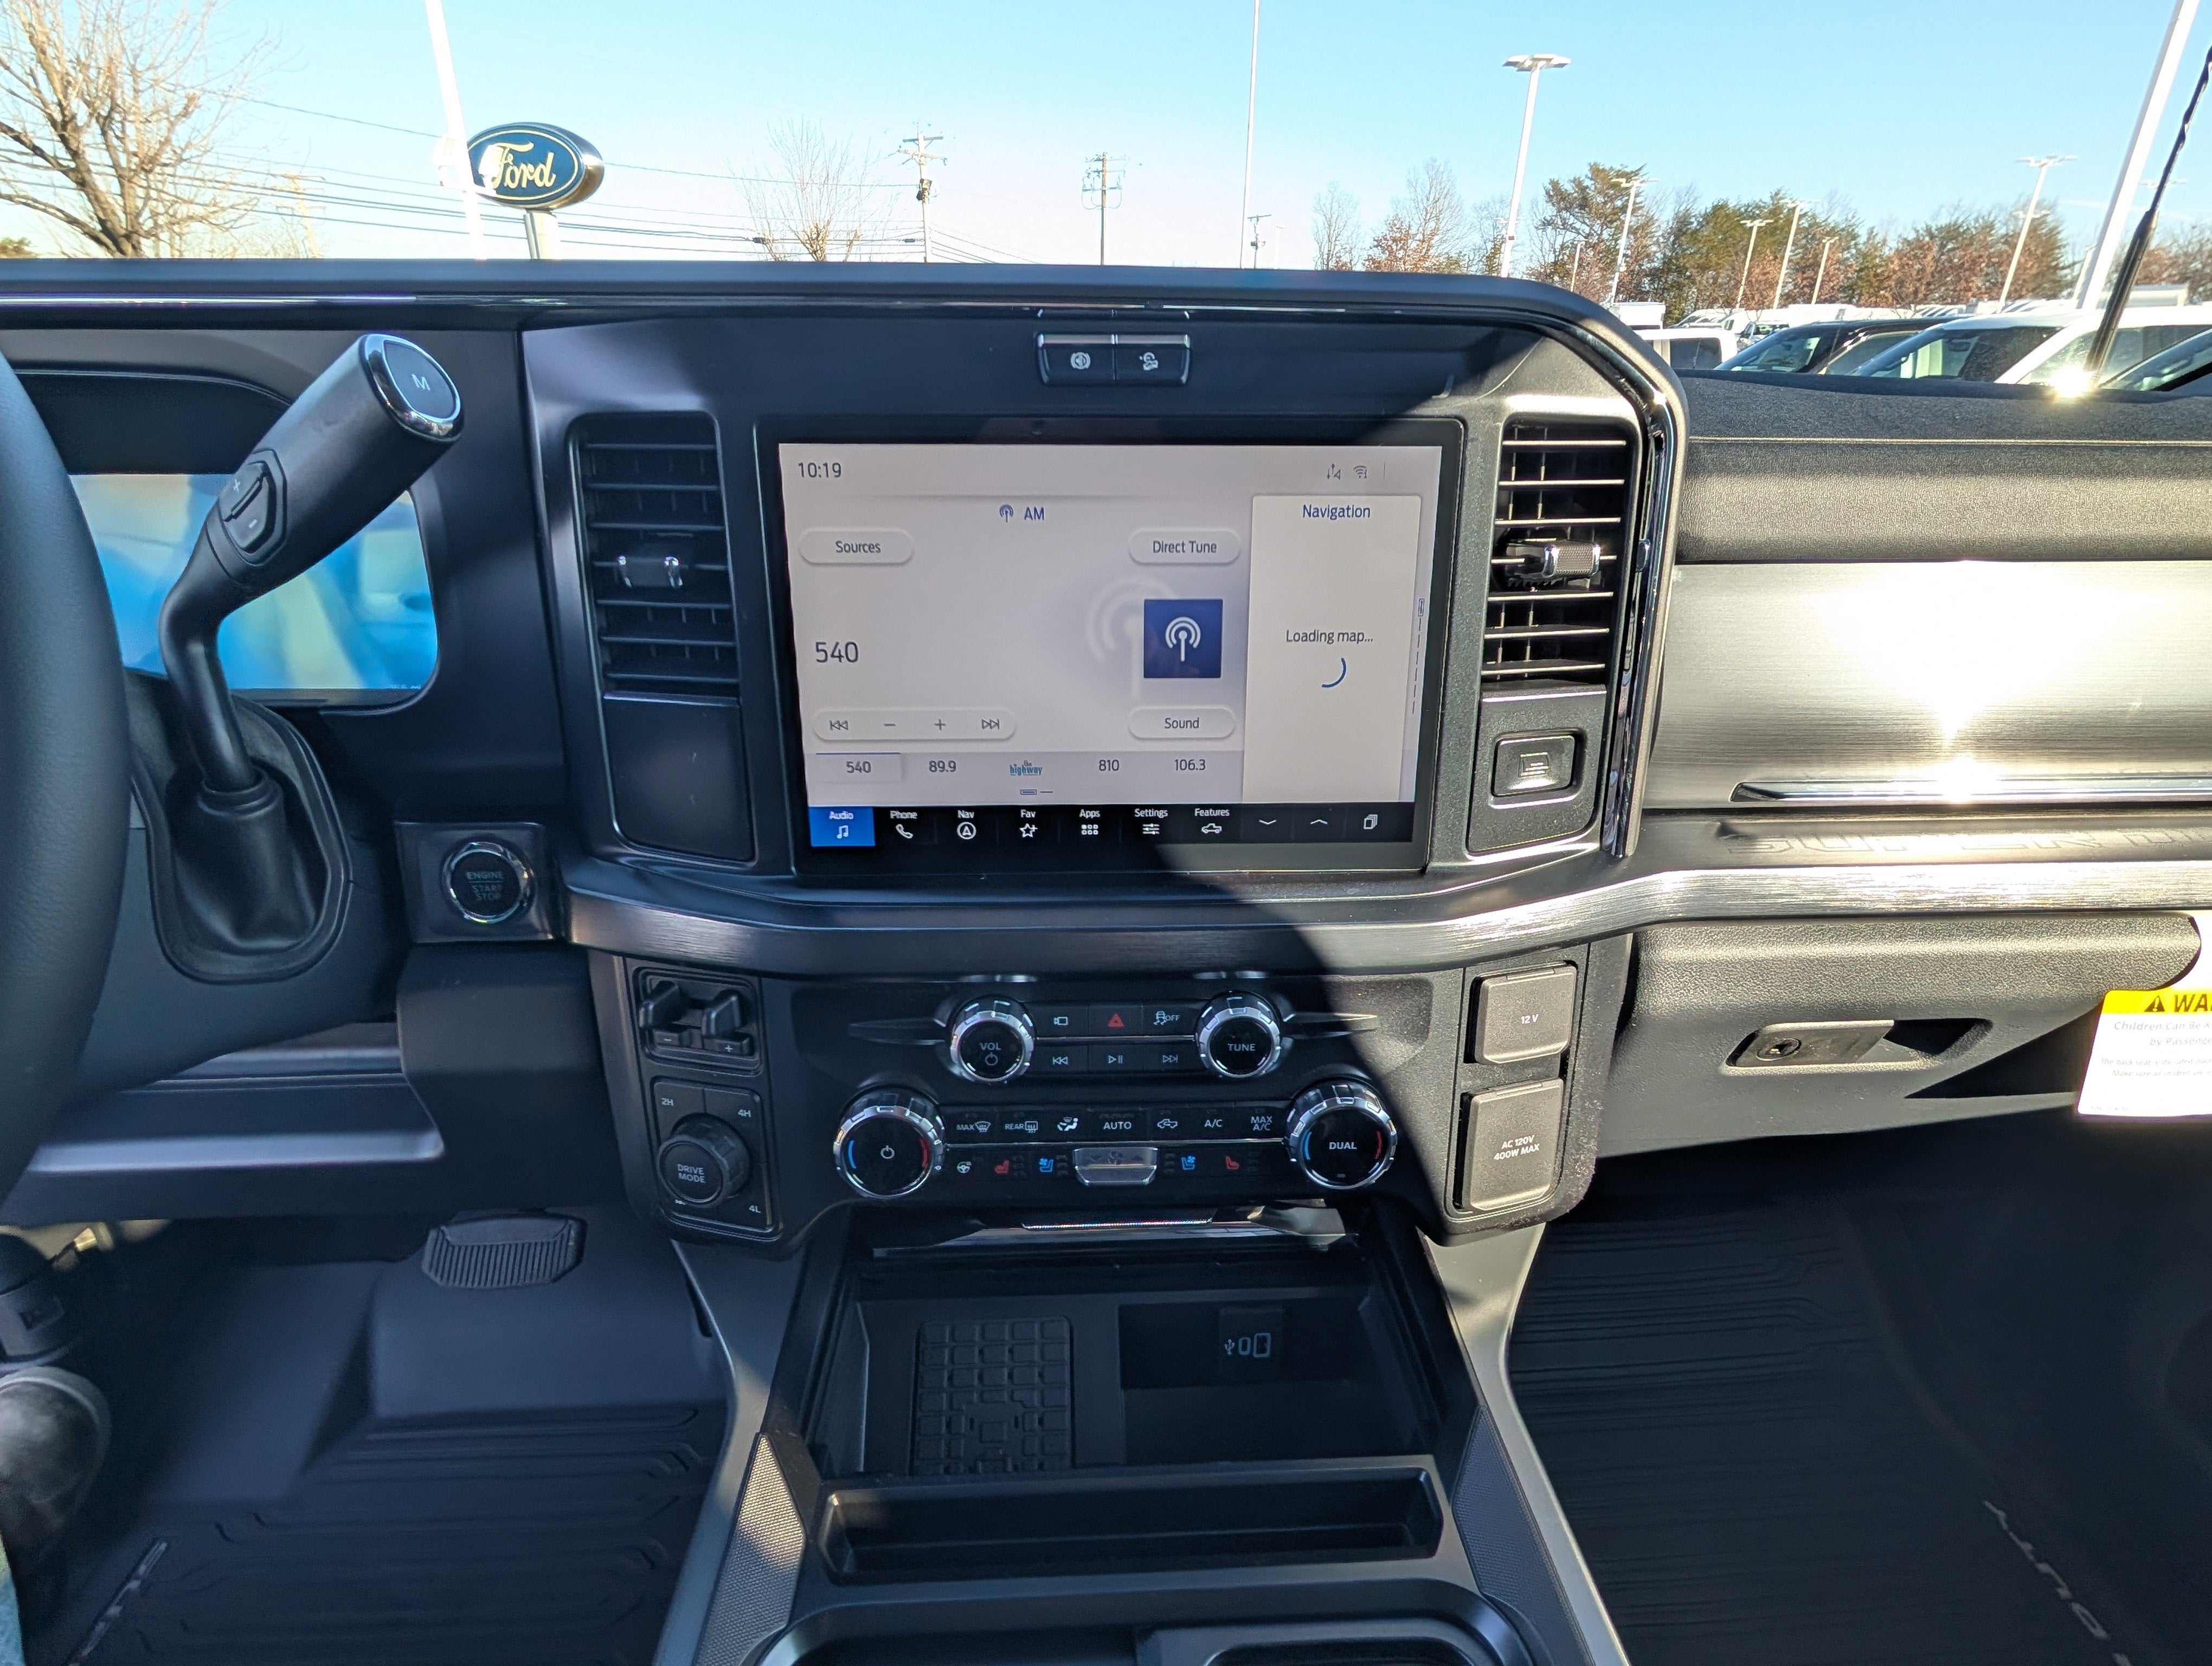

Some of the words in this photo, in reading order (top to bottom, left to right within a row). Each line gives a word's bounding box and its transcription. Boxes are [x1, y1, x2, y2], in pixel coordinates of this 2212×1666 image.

[488, 142, 556, 189] Ford
[411, 374, 431, 391] M
[798, 462, 841, 478] 10:19
[1024, 506, 1045, 521] AM
[1302, 504, 1371, 521] Navigation
[835, 540, 881, 554] Sources
[1153, 540, 1186, 554] Direct
[1188, 540, 1217, 554] Tune
[1286, 629, 1335, 645] Loading
[1337, 632, 1373, 645] map...
[815, 641, 859, 663] 540
[1164, 716, 1200, 729] Sound
[846, 760, 872, 773] 540
[928, 760, 956, 773] 89.9
[1098, 759, 1120, 772] 810
[1174, 759, 1206, 771] 106.3
[829, 811, 854, 820] Audio
[890, 810, 918, 819] Phone
[957, 810, 975, 819] Nav
[1020, 809, 1036, 818] Fav
[1079, 809, 1101, 819] Apps
[1134, 808, 1168, 819] Settings
[1194, 808, 1230, 817] Features
[467, 872, 504, 880] ENGINE
[2174, 994, 2212, 1013] WA
[1521, 1015, 1531, 1024] 12
[1532, 1014, 1539, 1023] V
[2114, 1021, 2162, 1030] Children
[979, 1042, 1002, 1051] VOL
[1227, 1043, 1256, 1052] TUNE
[661, 1097, 674, 1106] 2H
[737, 1109, 751, 1118] 4H
[1103, 1121, 1132, 1130] AUTO
[1204, 1119, 1223, 1128] A/C
[1250, 1116, 1273, 1124] MAX
[1252, 1123, 1271, 1131] A/C
[1329, 1142, 1357, 1150] DUAL
[1501, 1140, 1513, 1150] AC
[1514, 1135, 1535, 1147] 120V
[1493, 1148, 1519, 1161] 400W
[1520, 1143, 1540, 1155] MAX
[677, 1163, 704, 1175] DRIVE
[678, 1172, 705, 1183] MODE
[749, 1205, 761, 1213] 4L
